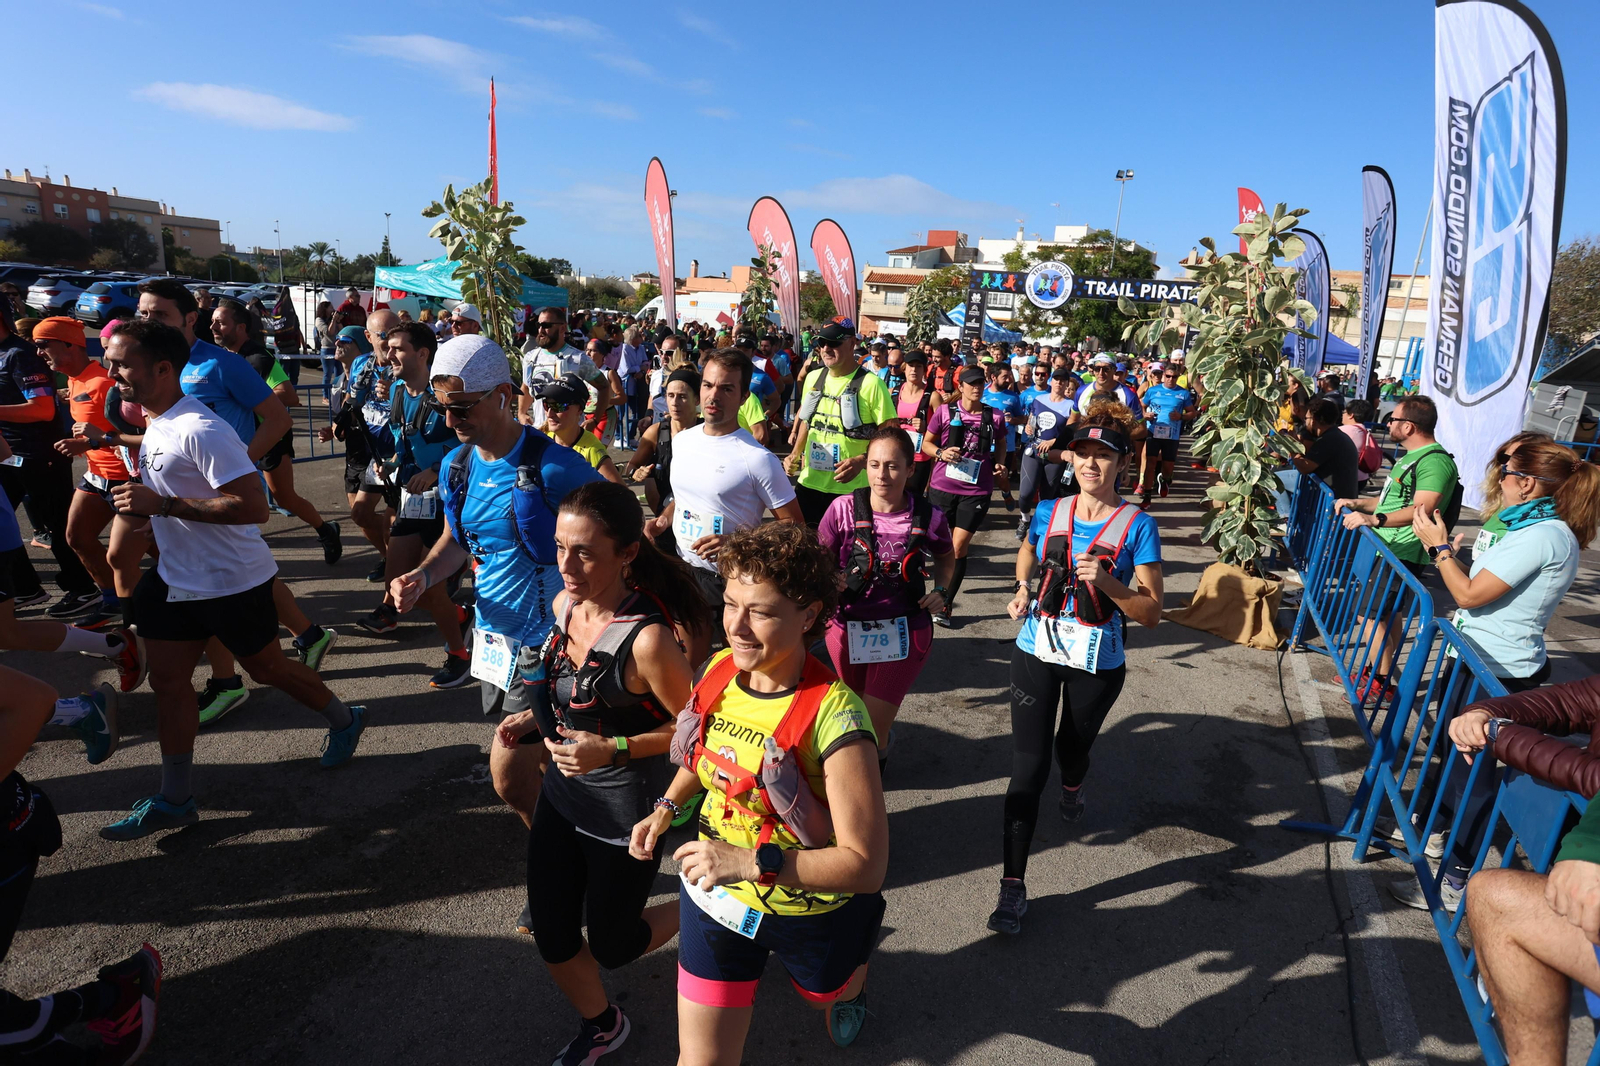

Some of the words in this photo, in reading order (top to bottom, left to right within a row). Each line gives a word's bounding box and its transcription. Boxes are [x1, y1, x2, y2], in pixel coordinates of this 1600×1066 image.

[1085, 280, 1135, 297] TRAIL
[811, 451, 826, 461] 682
[680, 521, 703, 538] 517
[860, 633, 889, 648] 778
[899, 620, 908, 657] PIRATILLA
[481, 646, 504, 667] 588
[1086, 631, 1098, 671] PIRATILLA
[832, 709, 853, 720] JUNTOS
